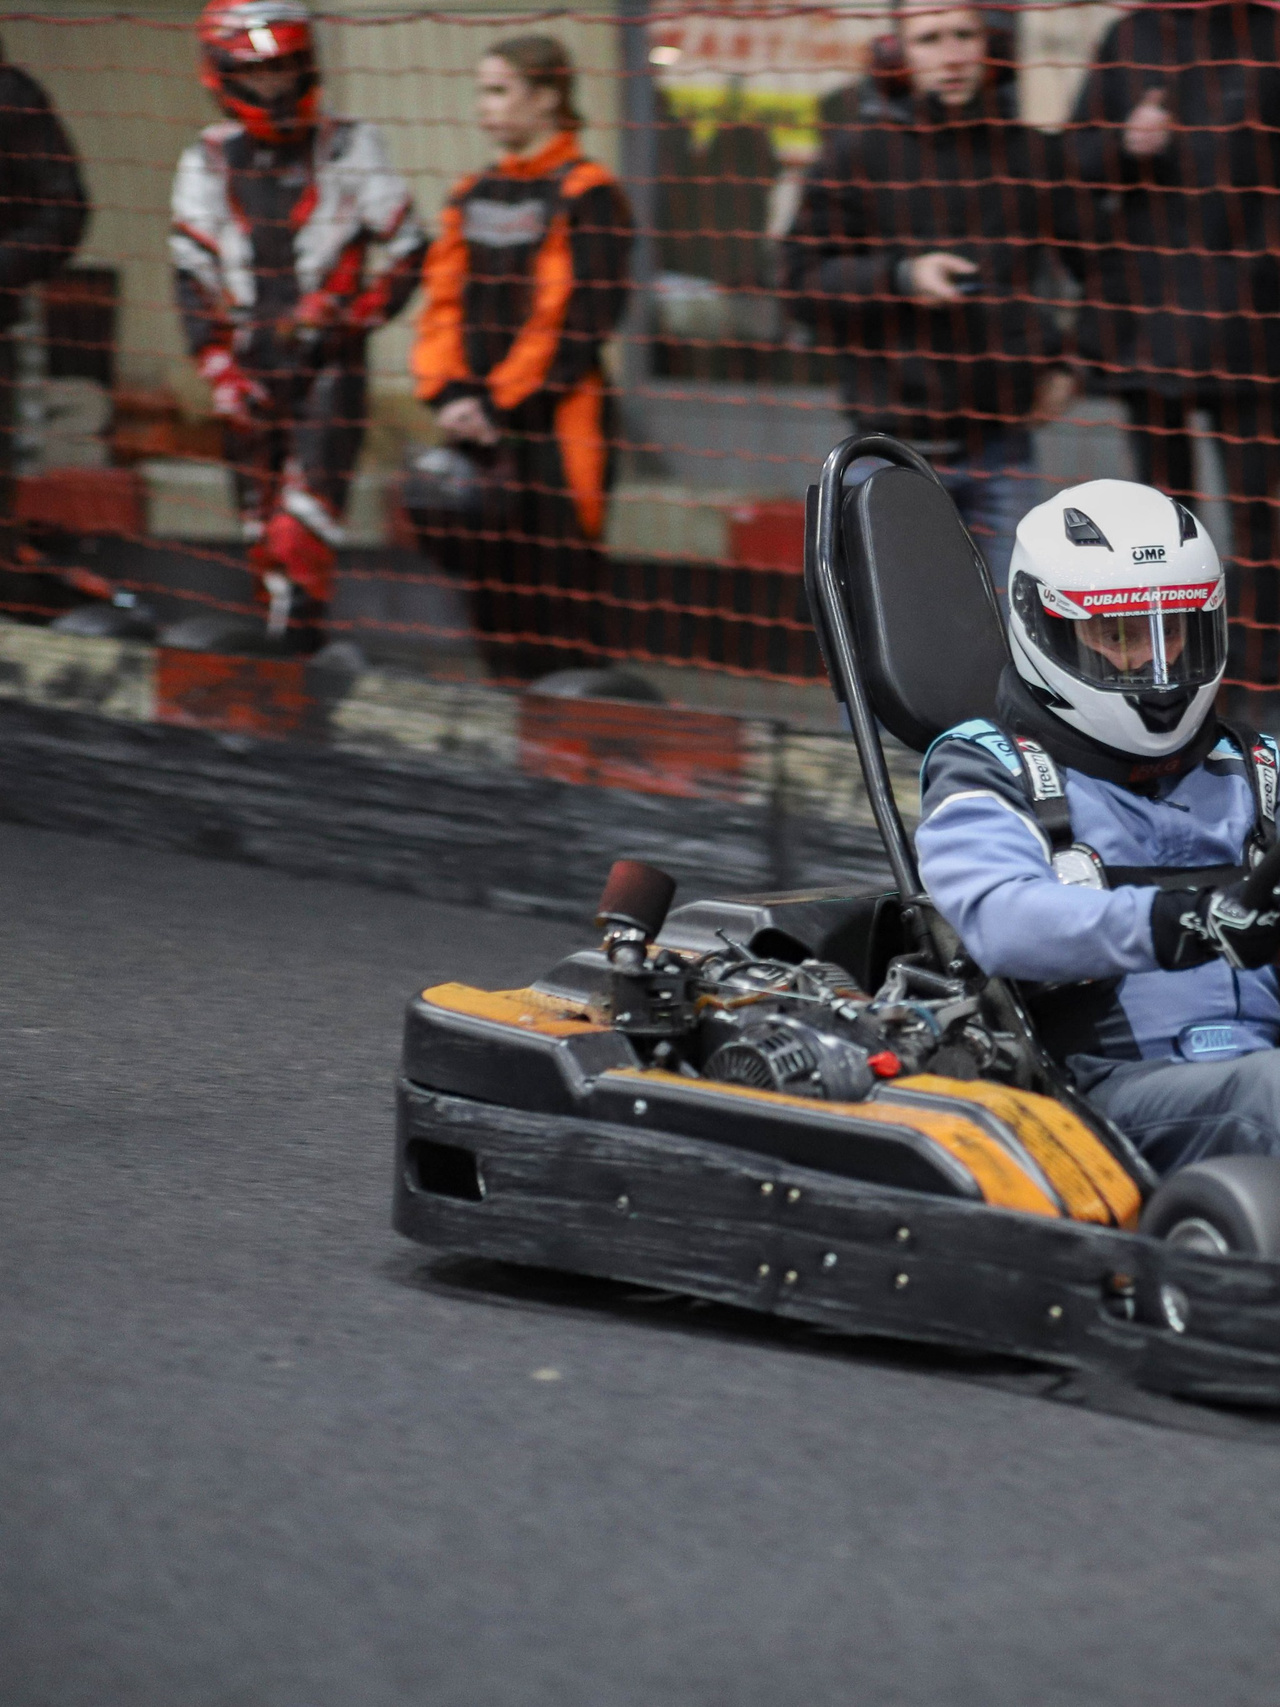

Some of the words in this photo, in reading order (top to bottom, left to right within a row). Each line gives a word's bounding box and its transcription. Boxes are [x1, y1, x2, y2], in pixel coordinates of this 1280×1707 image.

[1132, 548, 1166, 561] OMP
[1083, 592, 1128, 607] DUBAI
[1130, 588, 1208, 603] KARTDROME
[1032, 754, 1057, 793] freem
